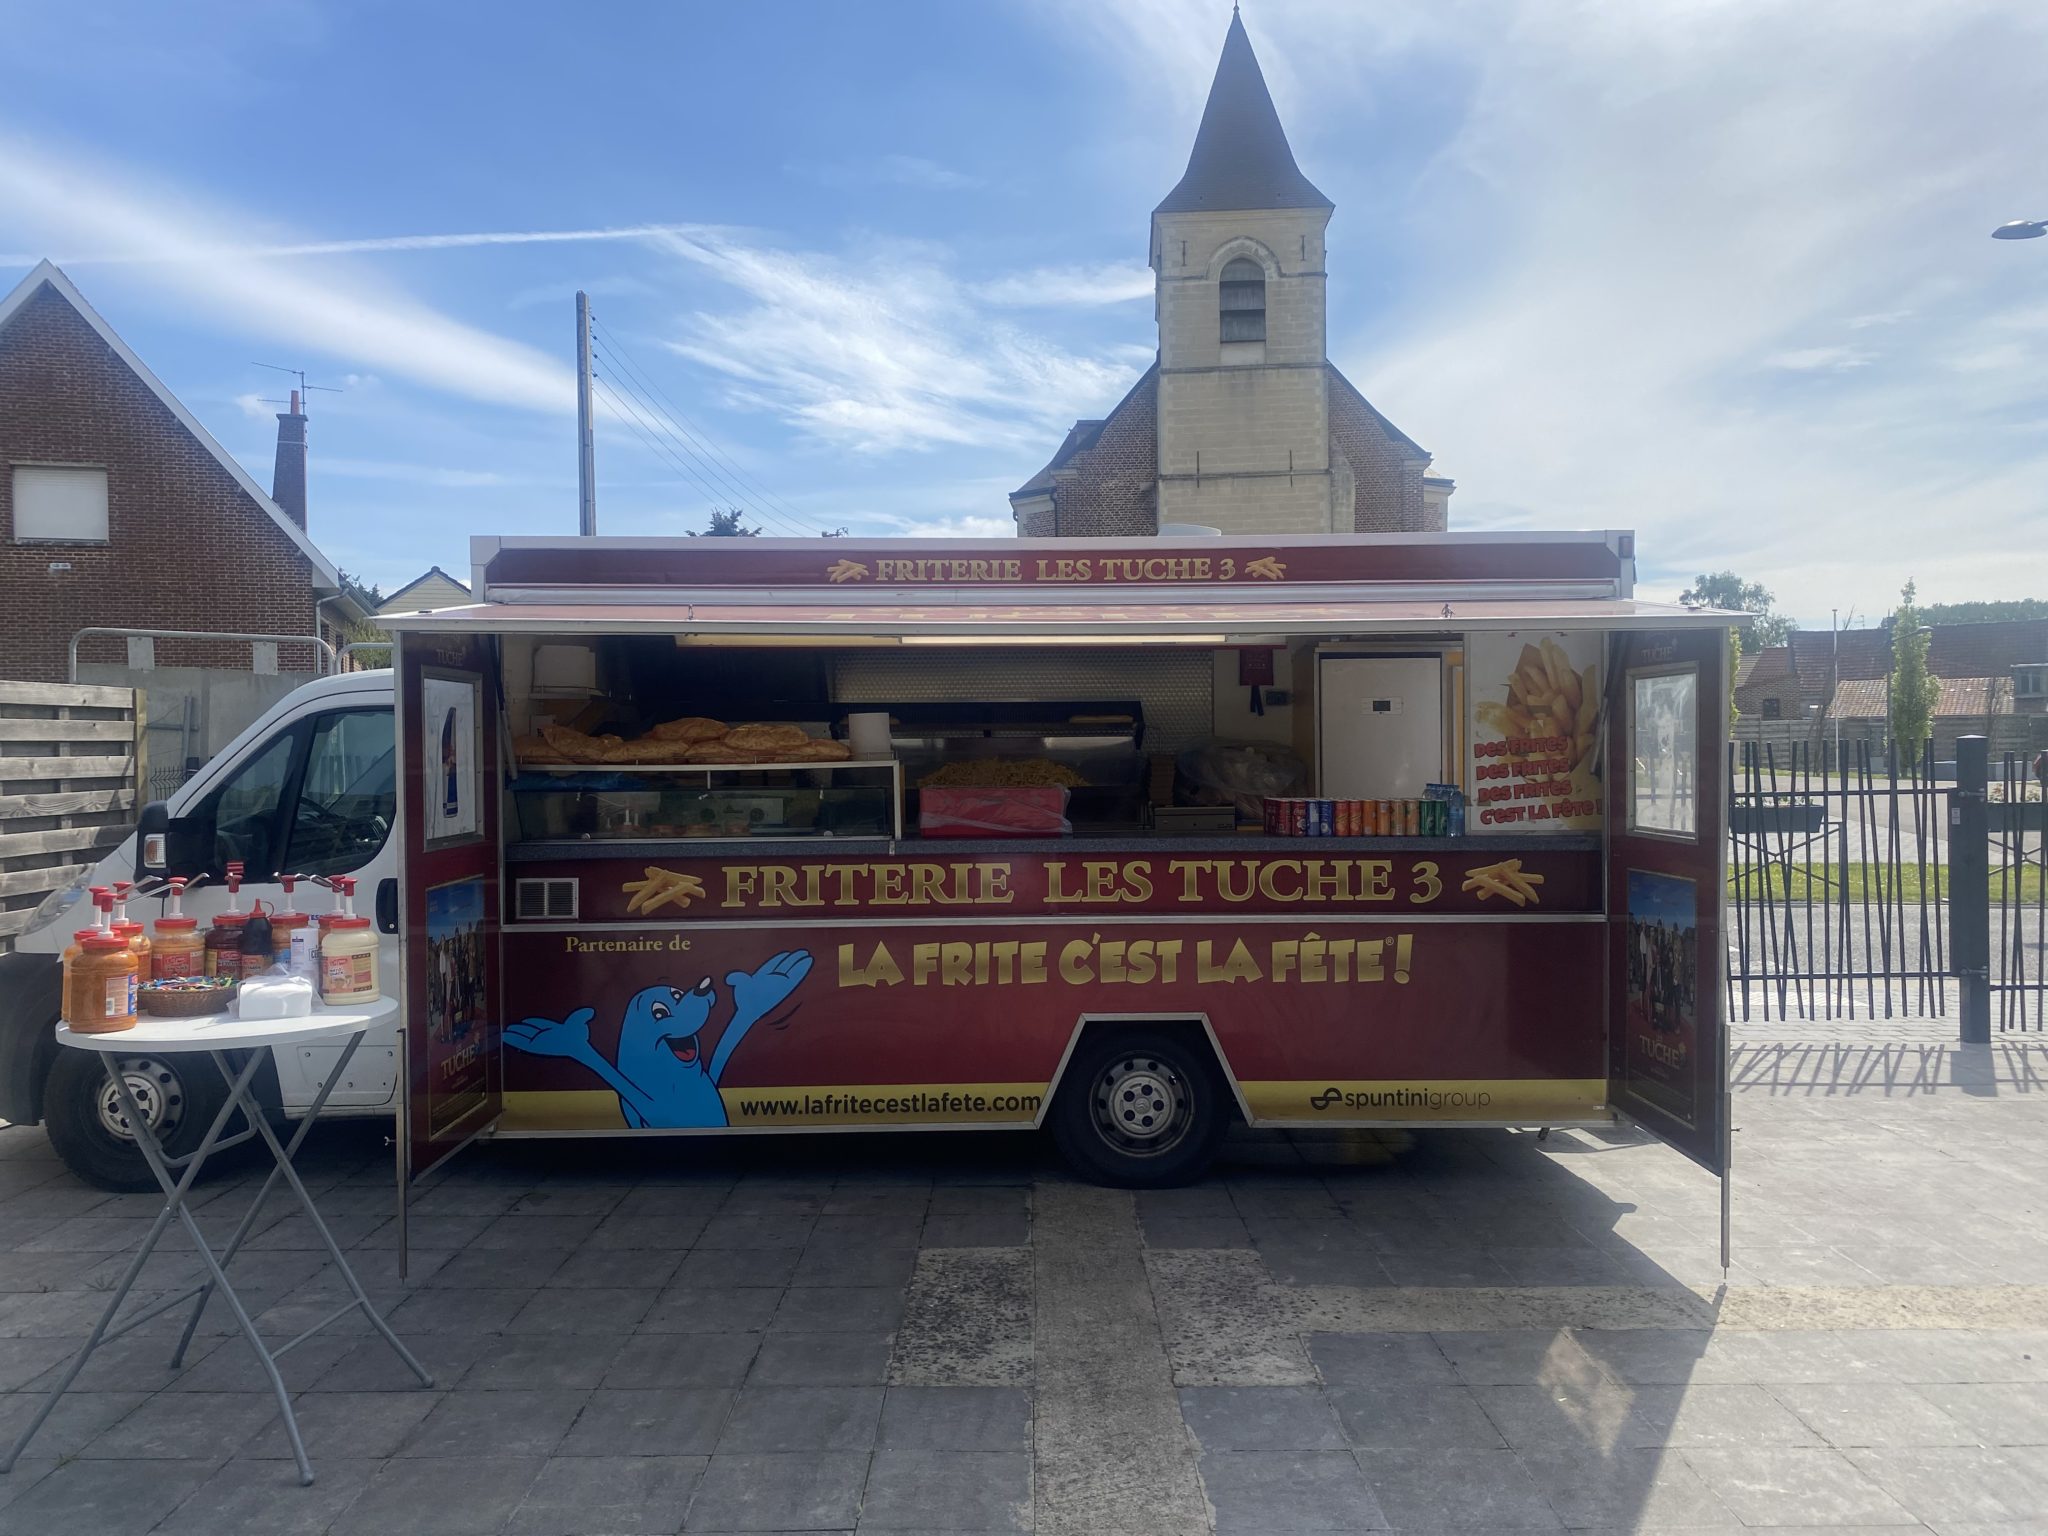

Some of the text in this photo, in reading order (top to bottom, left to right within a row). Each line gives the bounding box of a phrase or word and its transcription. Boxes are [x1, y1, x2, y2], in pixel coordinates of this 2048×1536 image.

[875, 557, 1236, 582] FRITERIE LES TUCHE 3
[1528, 804, 1551, 820] LA
[721, 859, 1442, 907] FRITERIE LES TUCHE 3
[565, 934, 692, 953] Partenaire de
[838, 939, 904, 988] LA
[912, 939, 1049, 986] FRITE
[1059, 932, 1184, 986] C'EST
[1196, 937, 1263, 984] LA
[440, 1043, 476, 1081] TUCHE
[1639, 1034, 1681, 1070] TUCHE
[740, 1092, 1042, 1116] www.lafritecestlafete.com
